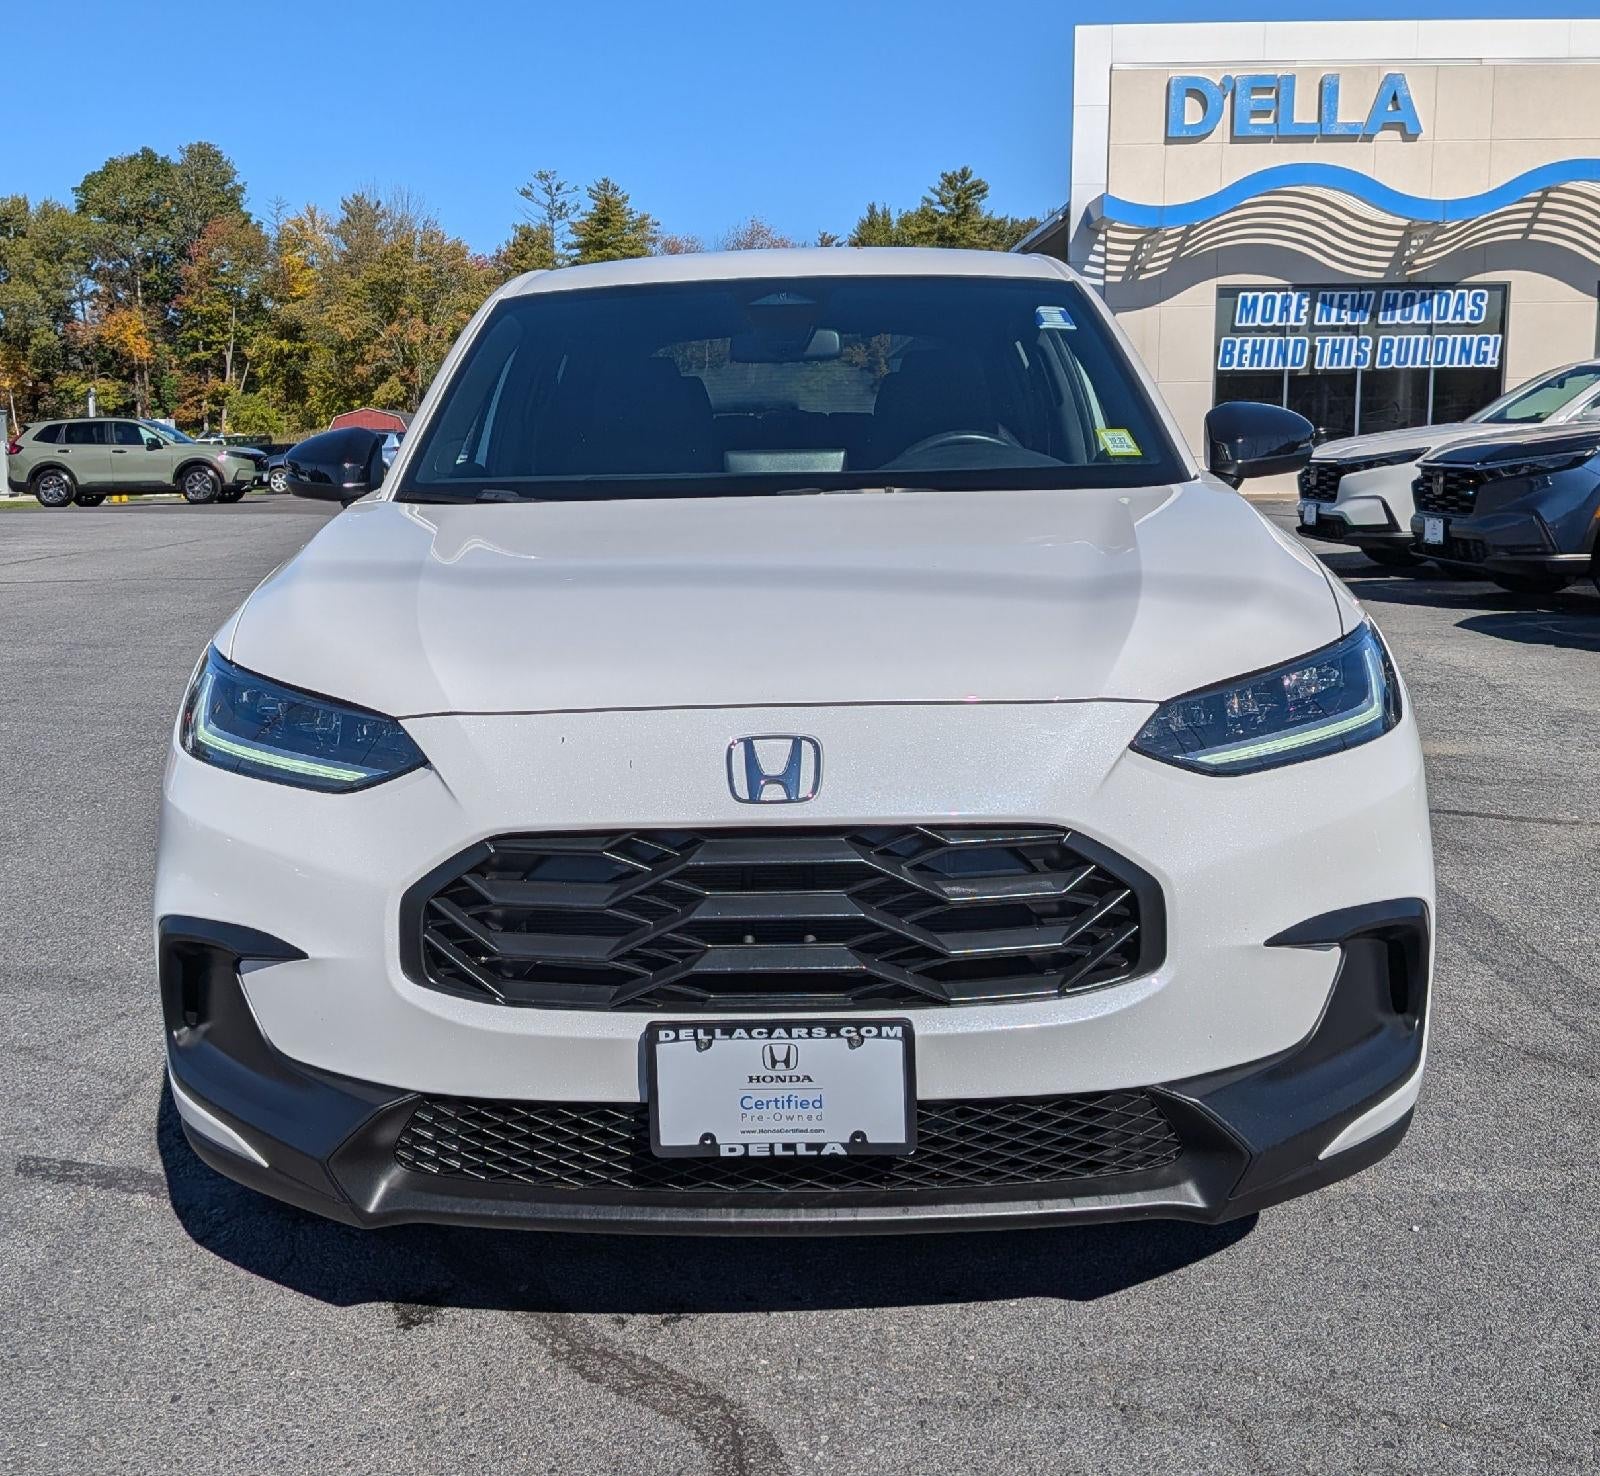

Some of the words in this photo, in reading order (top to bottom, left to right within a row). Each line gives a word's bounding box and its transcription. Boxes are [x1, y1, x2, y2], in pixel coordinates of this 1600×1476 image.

[1166, 72, 1423, 139] D'ELLA
[1234, 291, 1310, 326] MORE
[1314, 290, 1375, 325] NEW
[1378, 290, 1488, 324] HONDAS
[1217, 337, 1309, 370] BEHIND
[1314, 336, 1373, 370] THIS
[1375, 335, 1502, 369] BUILDING!
[658, 1026, 903, 1042] DELLACARS.COM
[747, 1075, 814, 1084] HONDA
[740, 1094, 823, 1110] Certified
[741, 1112, 823, 1122] Pre-Owned
[719, 1142, 847, 1157] DELLA
